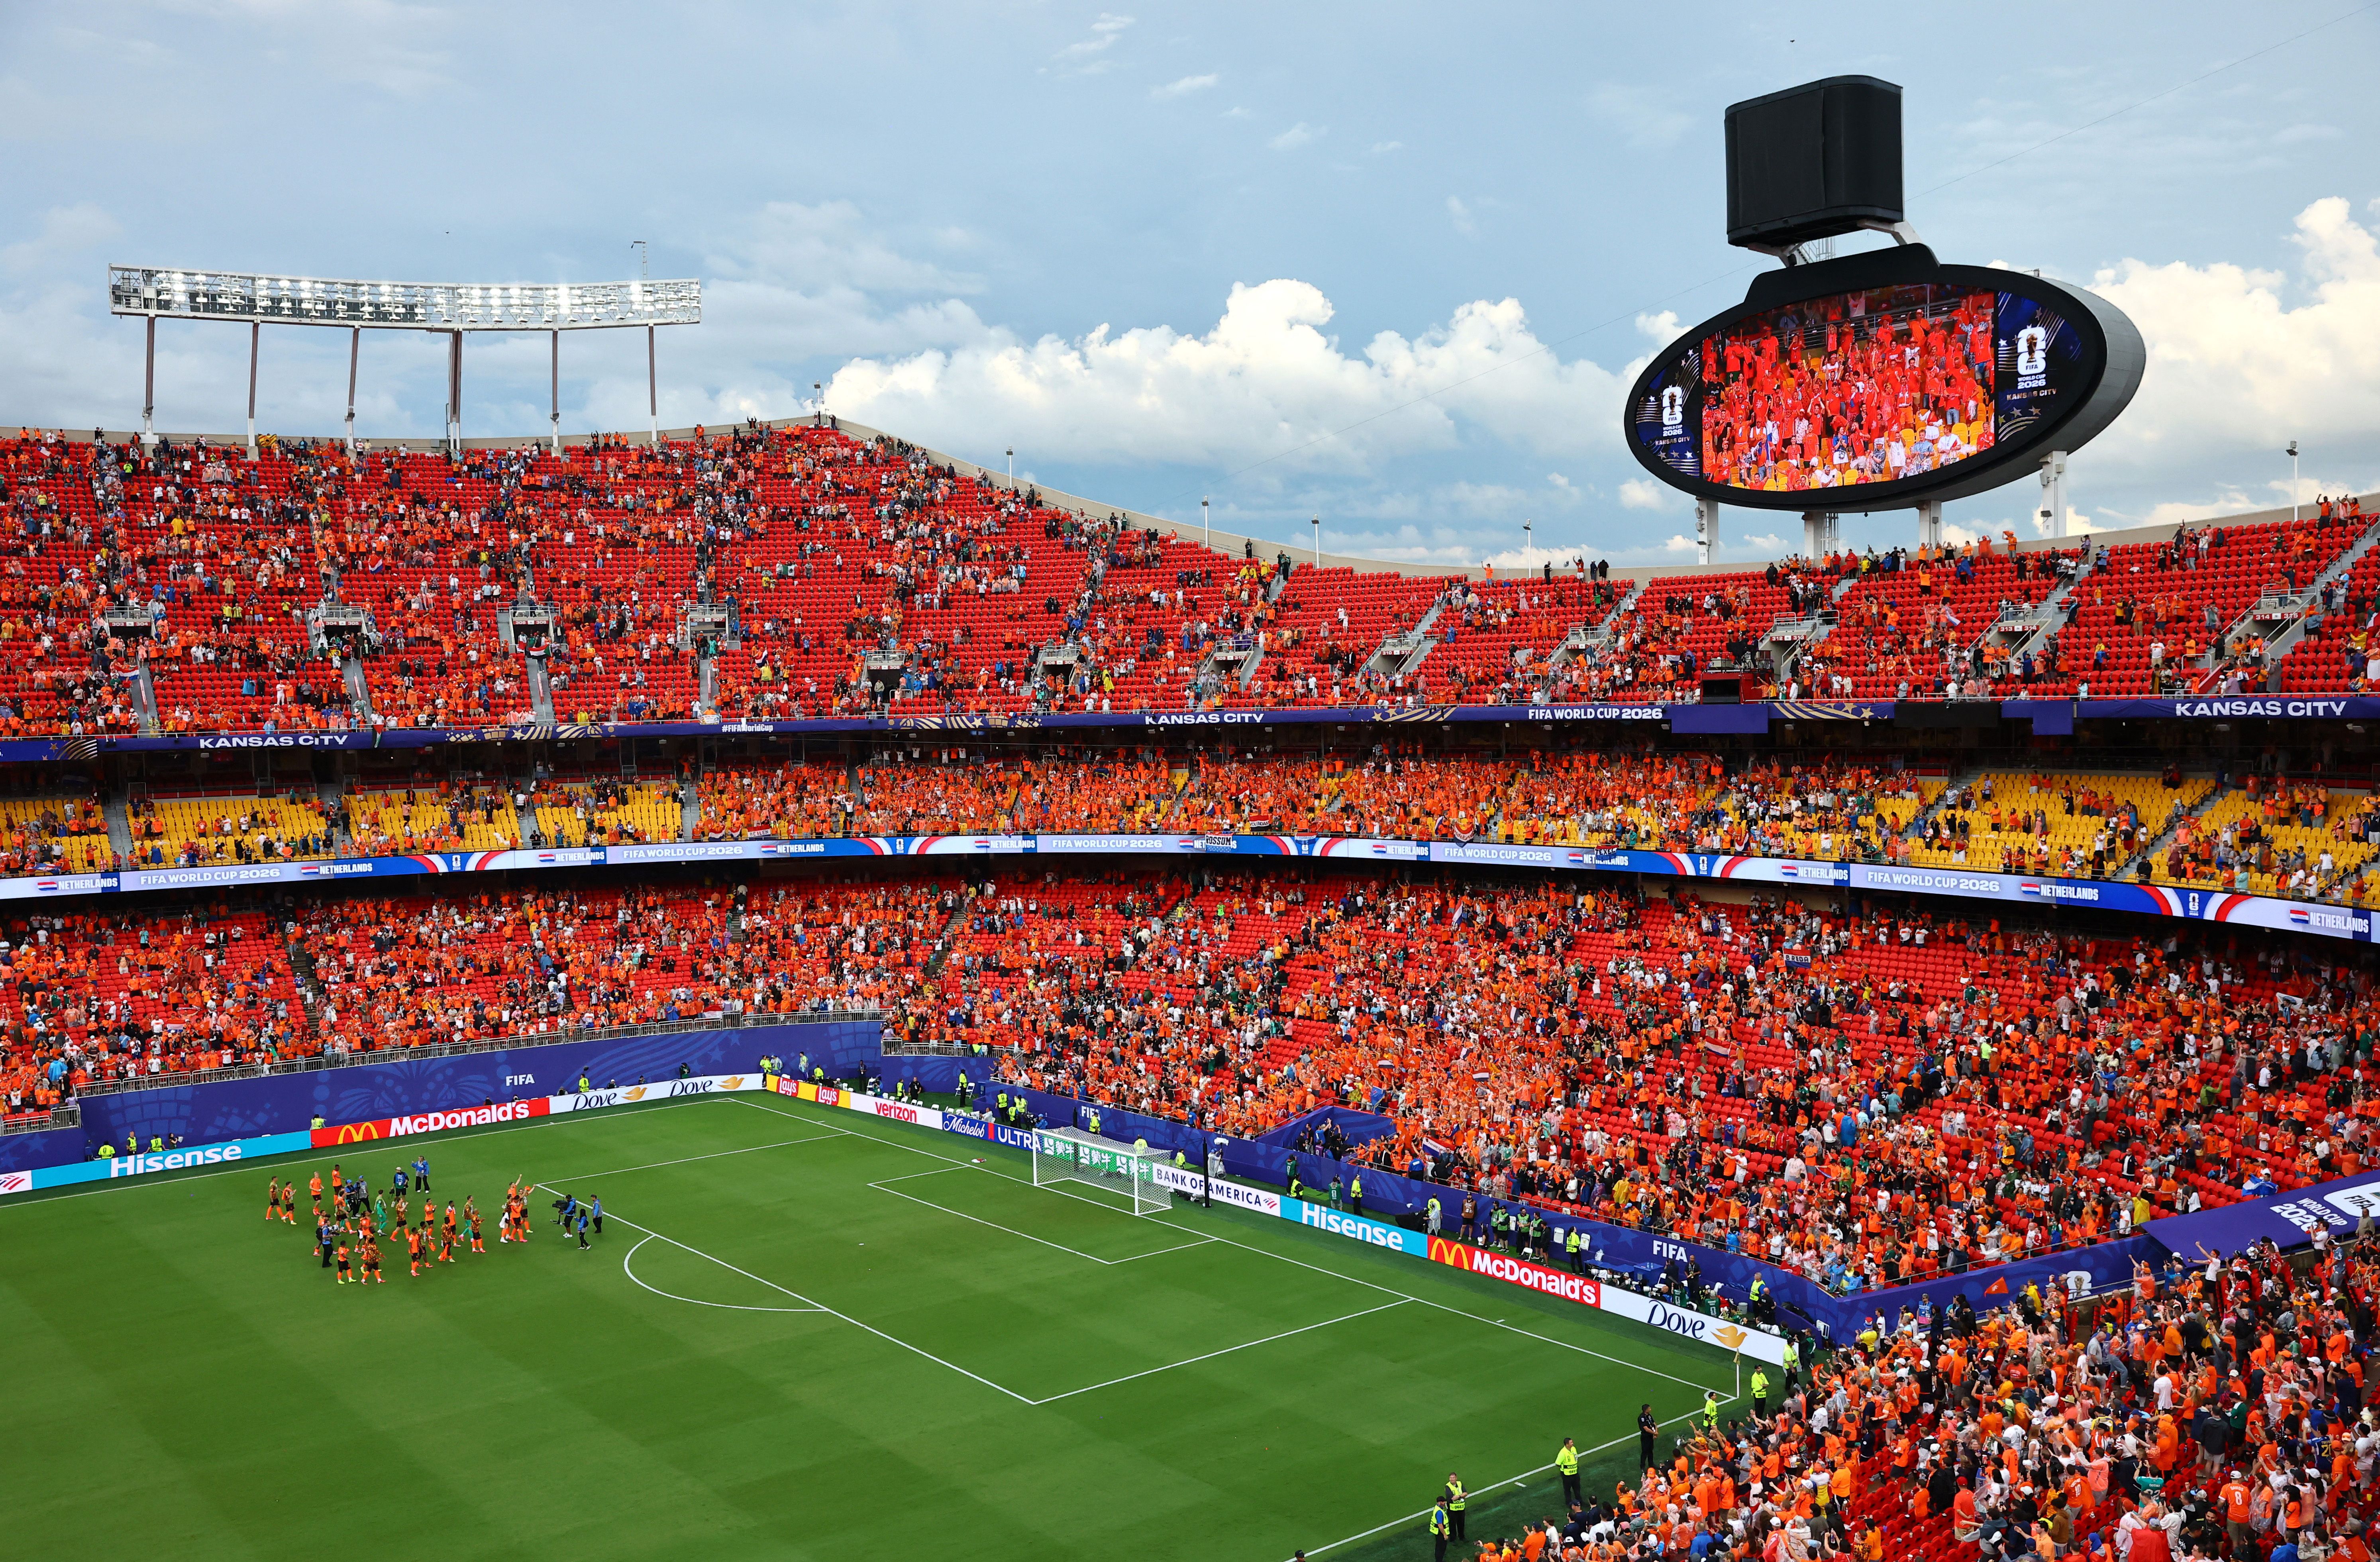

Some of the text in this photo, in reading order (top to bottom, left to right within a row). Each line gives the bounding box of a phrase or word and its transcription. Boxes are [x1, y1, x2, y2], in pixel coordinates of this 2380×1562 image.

[2017, 379, 2046, 389] 2026
[2007, 391, 2038, 400] KANSAS
[1663, 428, 1683, 437] 2026
[1528, 708, 1662, 719] FIFA WORLD CUP 2026
[2176, 701, 2347, 716] KANSAS CITY
[1145, 713, 1264, 724] KANSAS CITY
[200, 735, 348, 749] KANSAS CITY
[990, 840, 1035, 848] NETHERLANDS
[1052, 839, 1162, 848] FIFA WORLD CUP 2026
[1206, 835, 1231, 845] ROSSUM
[647, 848, 684, 857] WORLD
[685, 847, 705, 856] CUP
[707, 846, 743, 855] 2026
[777, 844, 824, 853] NETHERLANDS
[1387, 846, 1428, 856] NETHERLANDS
[1444, 848, 1552, 861] FIFA WORLD CUP 2026
[556, 852, 604, 861] NETHERLANDS
[320, 863, 372, 874] NETHERLANDS
[1798, 867, 1848, 880] NETHERLANDS
[140, 868, 280, 885] FIFA WORLD CUP 2026
[1868, 871, 2000, 892] FIFA WORLD CUP 2026
[58, 878, 118, 891] NETHERLANDS
[2041, 884, 2098, 901] NETHERLANDS
[2310, 912, 2368, 933] NETHERLANDS
[506, 1074, 535, 1086] FIFA
[779, 1077, 797, 1096] Lay's
[670, 1080, 712, 1097] Dove
[818, 1086, 837, 1105] Lay's
[573, 1093, 617, 1111] Dove
[875, 1101, 917, 1123] verizon
[389, 1102, 529, 1137] McDonald's
[943, 1114, 1042, 1151] Michelob ULTRA
[110, 1145, 241, 1178] Hisense
[1157, 1169, 1261, 1206] BANK OF AMERICA
[2344, 1195, 2376, 1210] FIFA
[2296, 1197, 2347, 1225] WORLD CUP
[1302, 1201, 1403, 1251] Hisense
[1653, 1240, 1688, 1262] FIFA
[1472, 1250, 1596, 1304] McDonald's
[1647, 1299, 1705, 1339] Dove
[2075, 1484, 2081, 1497] 10
[2235, 1491, 2243, 1505] 8
